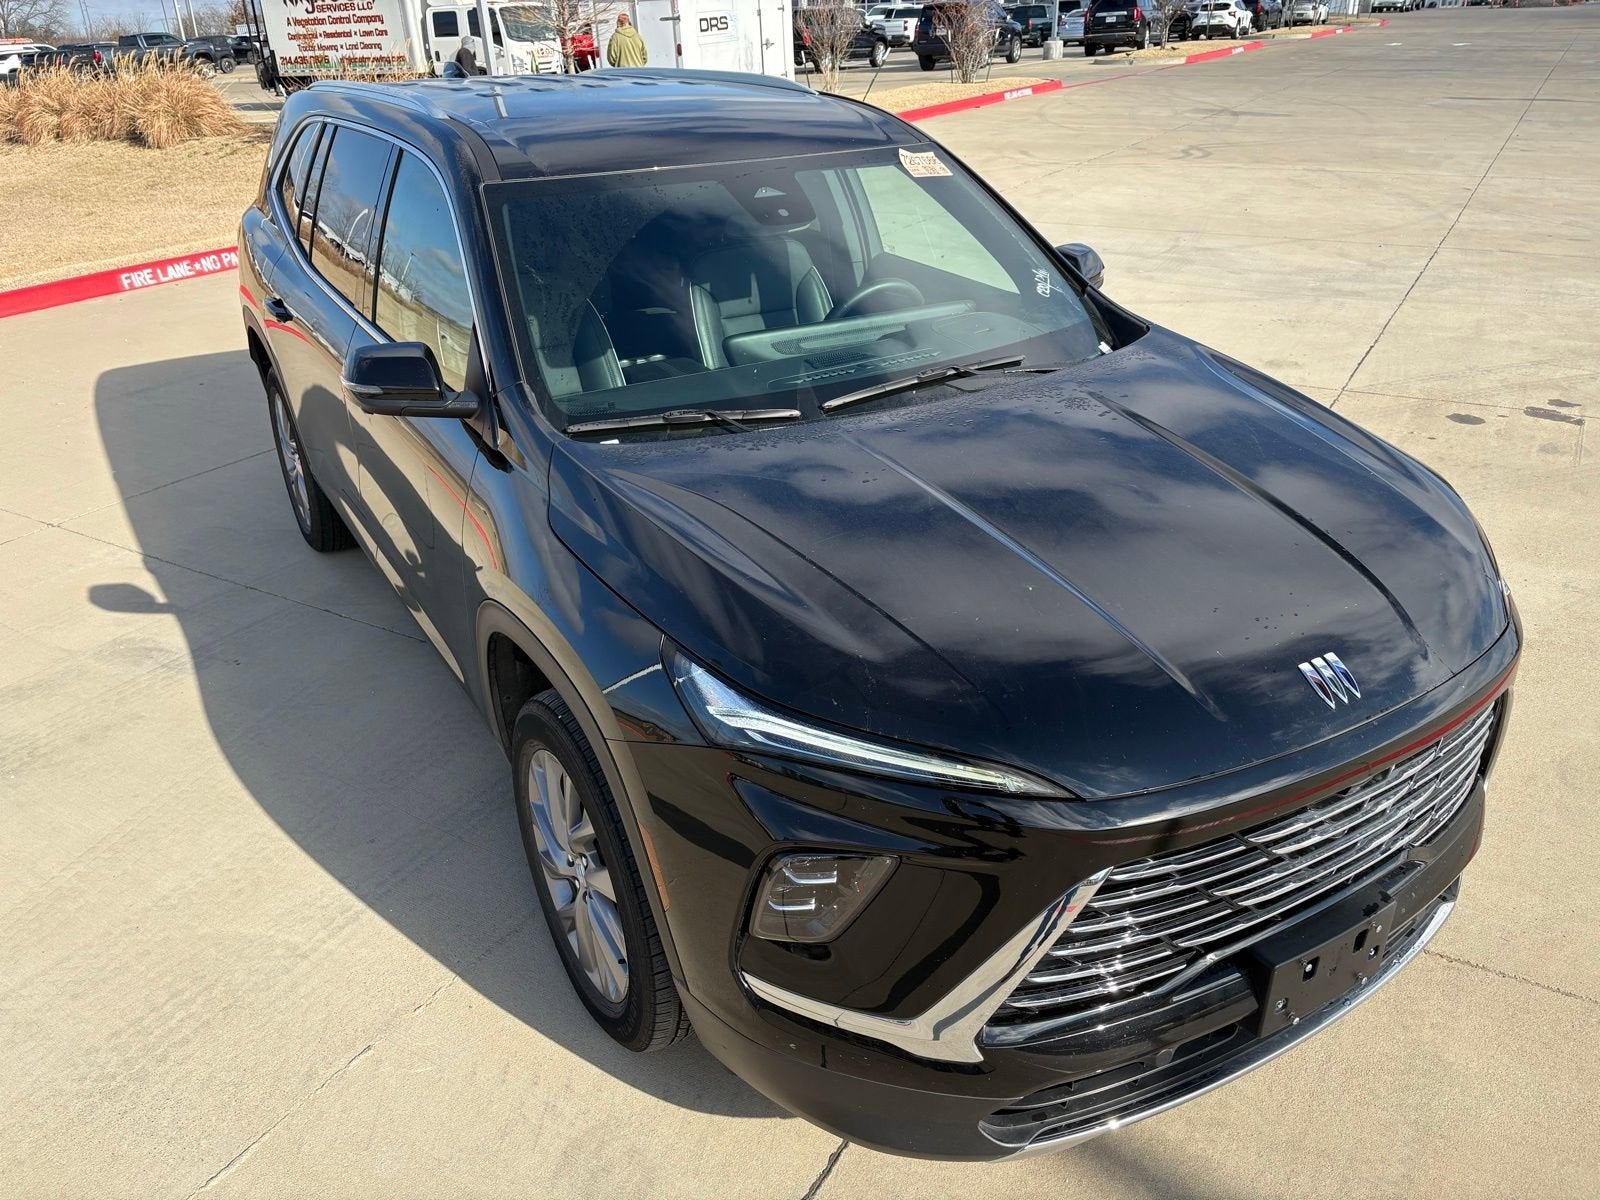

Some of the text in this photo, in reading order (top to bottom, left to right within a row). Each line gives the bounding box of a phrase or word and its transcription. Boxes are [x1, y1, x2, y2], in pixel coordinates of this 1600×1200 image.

[317, 3, 356, 13] SERVICES
[357, 2, 373, 11] LLC
[287, 14, 384, 28] A Vegetation Control Company
[699, 16, 728, 32] DRS
[323, 29, 352, 39] Residential
[359, 29, 374, 37] Lawn
[375, 28, 388, 37] Care
[317, 43, 338, 52] Mowing
[345, 42, 359, 50] Land
[360, 41, 382, 50] Clearing
[120, 251, 240, 289] FIRE LANE NO PA
